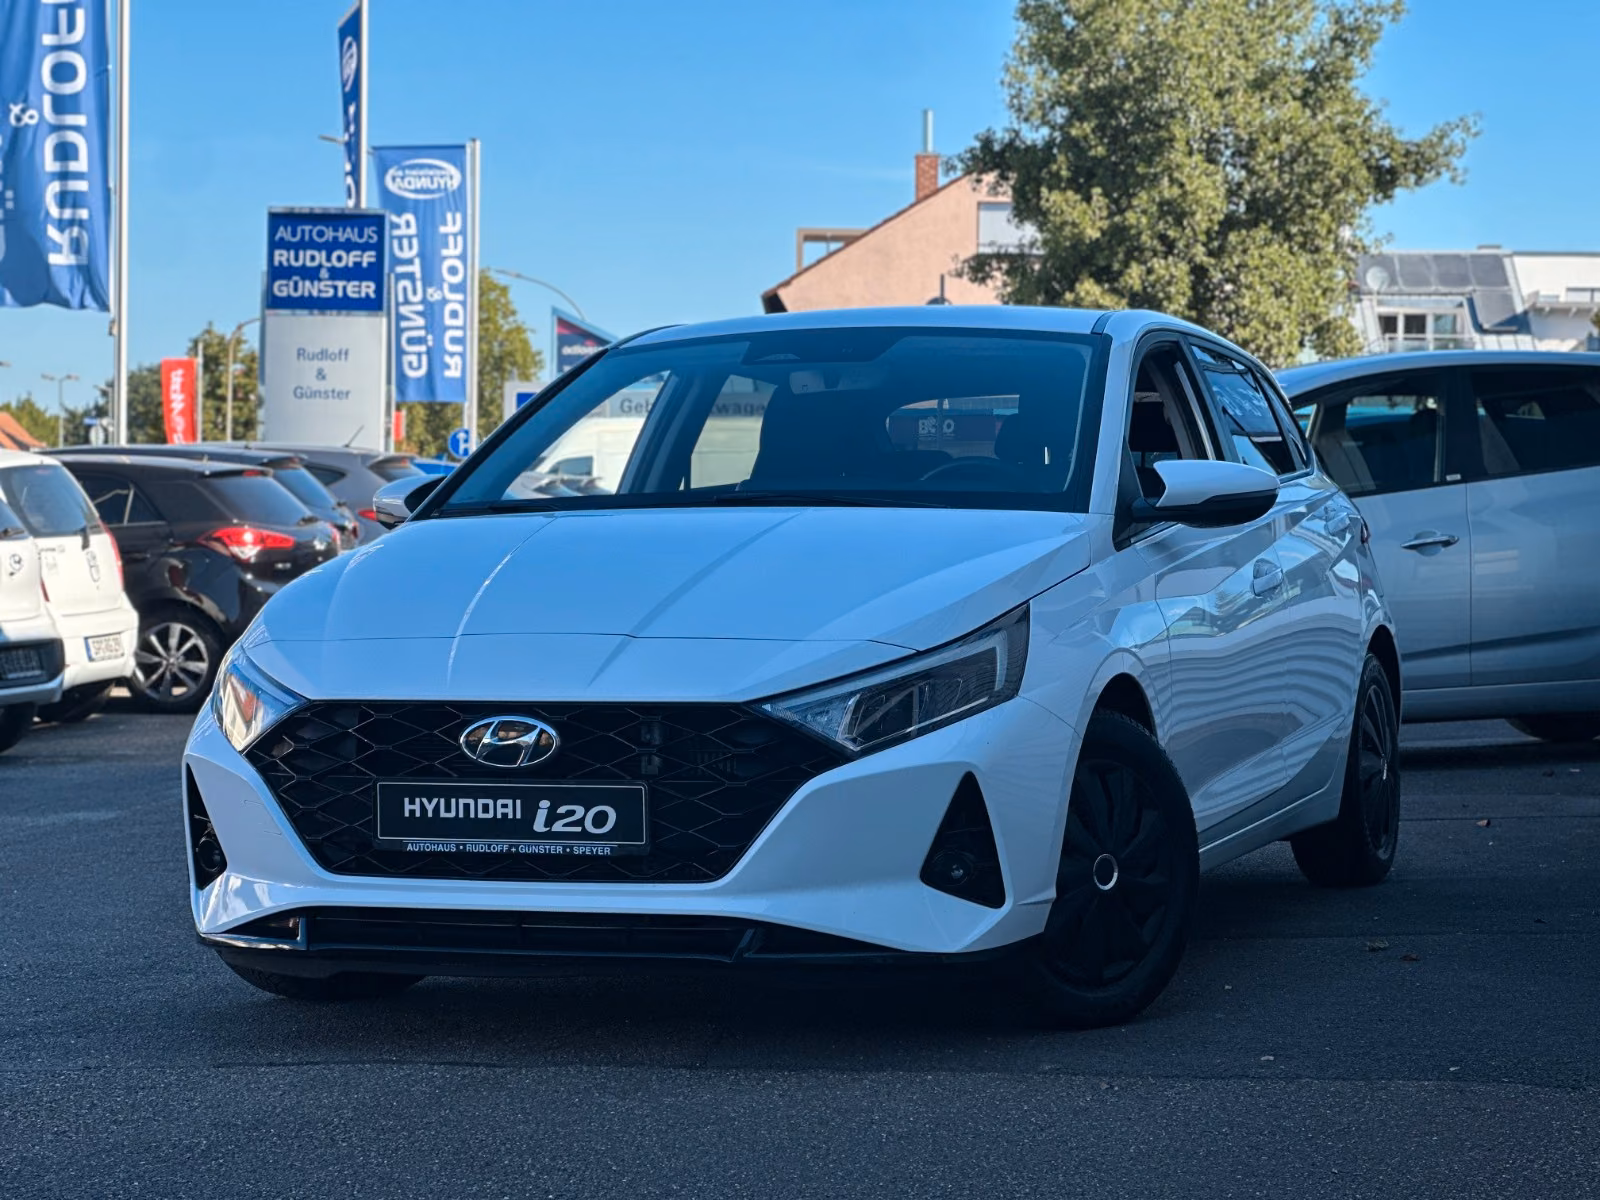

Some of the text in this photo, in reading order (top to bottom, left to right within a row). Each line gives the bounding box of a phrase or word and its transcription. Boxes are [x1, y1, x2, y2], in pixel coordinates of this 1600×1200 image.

[275, 225, 378, 243] AUTOHAUS
[273, 249, 377, 268] RUDLOFF
[319, 267, 330, 279] &
[272, 276, 376, 298] GÜNSTER
[297, 347, 349, 361] Rudloff
[315, 367, 327, 381] &
[293, 385, 351, 400] Günster
[403, 797, 617, 834] HYUNDAI i20
[406, 843, 456, 852] AUTOHAUS
[466, 844, 509, 853] RUDLOFF
[573, 846, 611, 855] SPEYER
